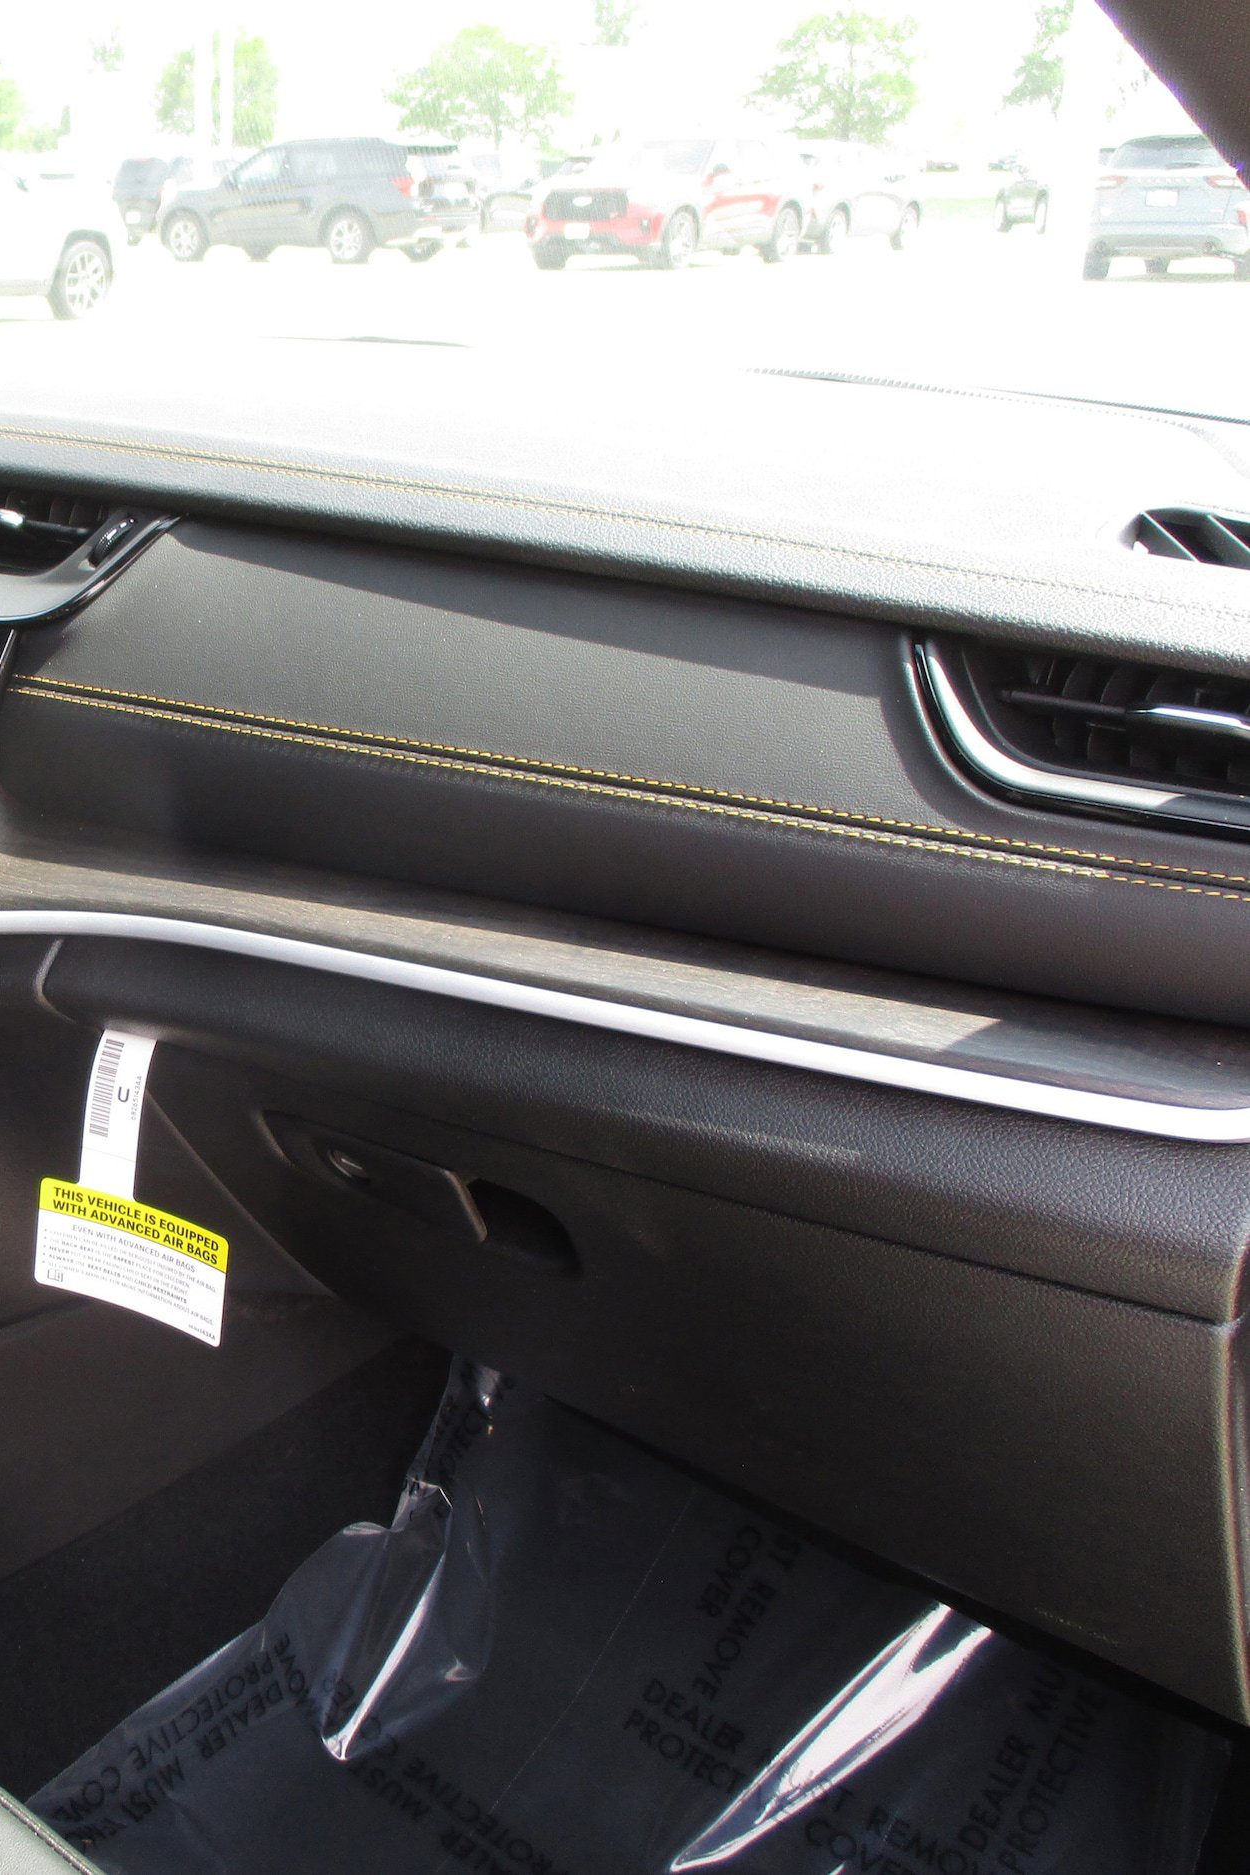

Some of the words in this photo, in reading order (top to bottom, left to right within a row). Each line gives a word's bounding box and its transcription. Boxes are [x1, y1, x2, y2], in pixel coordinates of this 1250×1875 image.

[118, 1086, 130, 1103] U
[53, 1186, 84, 1203] THIS
[87, 1194, 142, 1220] VEHICLE
[144, 1213, 157, 1226] IS
[159, 1218, 219, 1253] EQUIPPED
[53, 1199, 87, 1217] WITH
[90, 1209, 161, 1241] ADVANCED
[163, 1234, 184, 1251] AIR
[186, 1242, 218, 1266] BAGS
[72, 1224, 94, 1236] EVEN
[96, 1231, 116, 1243] WITH
[118, 1237, 160, 1258] ADVANCED
[161, 1253, 175, 1264] AIR
[176, 1258, 196, 1274] BAGS
[697, 1524, 763, 1618] COVER
[127, 1650, 274, 1772] PROTECTIVE
[195, 1679, 284, 1762] DEALER
[641, 1678, 746, 1754] DEALER
[120, 1756, 186, 1824] MUST
[958, 1733, 1036, 1853] DEALER
[997, 1686, 1109, 1875] PROTECTIVE
[864, 1805, 979, 1875] REMO
